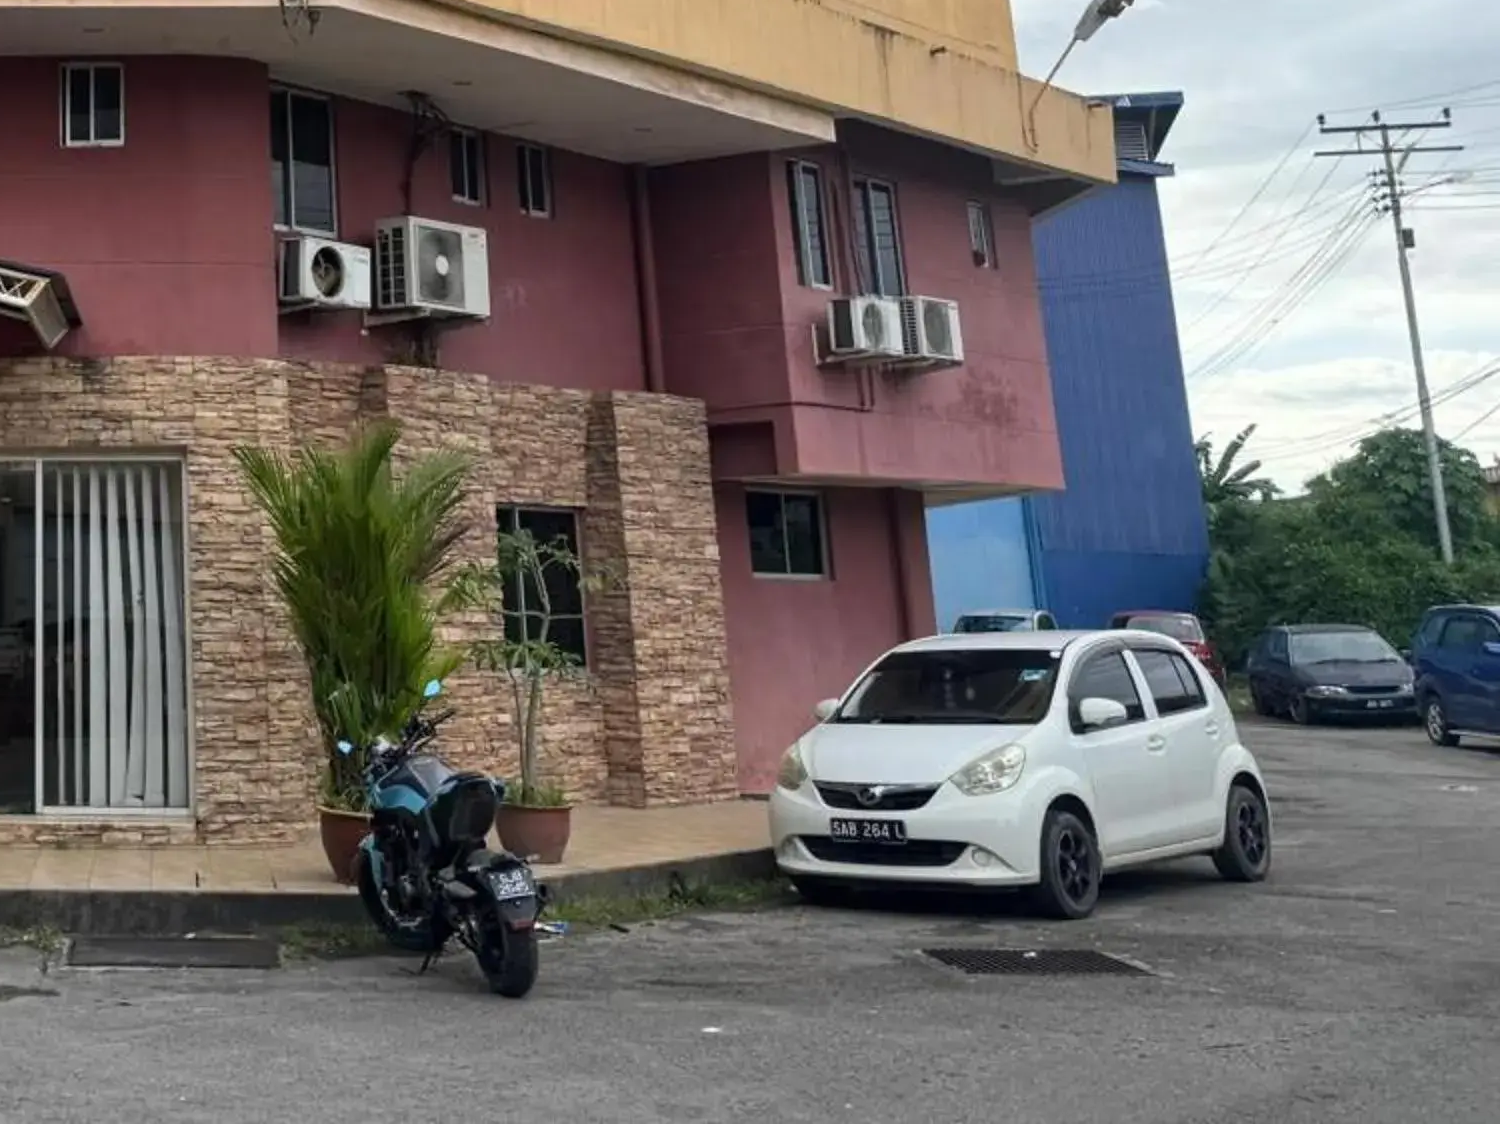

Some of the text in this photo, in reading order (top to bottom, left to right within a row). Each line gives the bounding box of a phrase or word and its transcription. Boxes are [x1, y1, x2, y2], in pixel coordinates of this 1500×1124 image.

[833, 820, 905, 839] SAB 264 L
